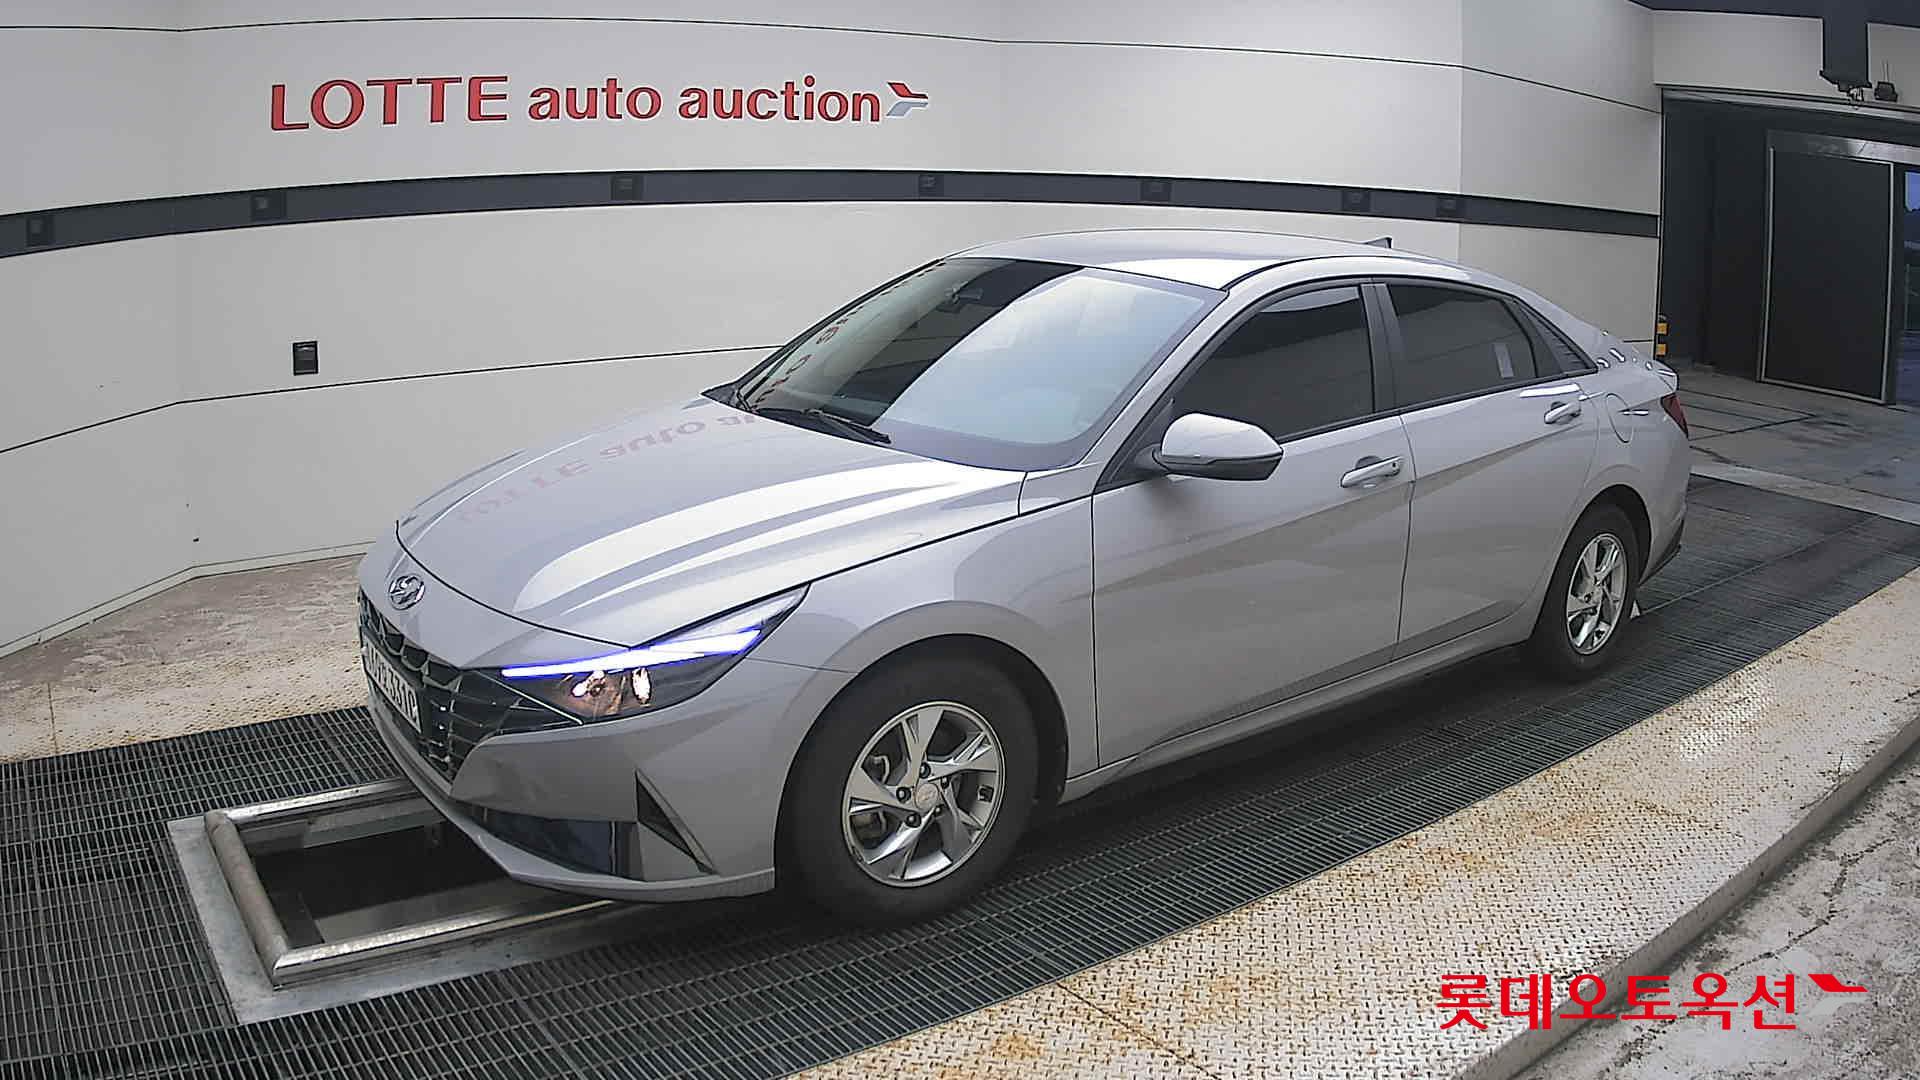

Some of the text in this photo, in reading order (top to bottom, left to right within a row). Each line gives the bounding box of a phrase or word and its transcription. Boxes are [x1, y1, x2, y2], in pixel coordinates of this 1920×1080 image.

[271, 75, 880, 131] LOTTE auto auction
